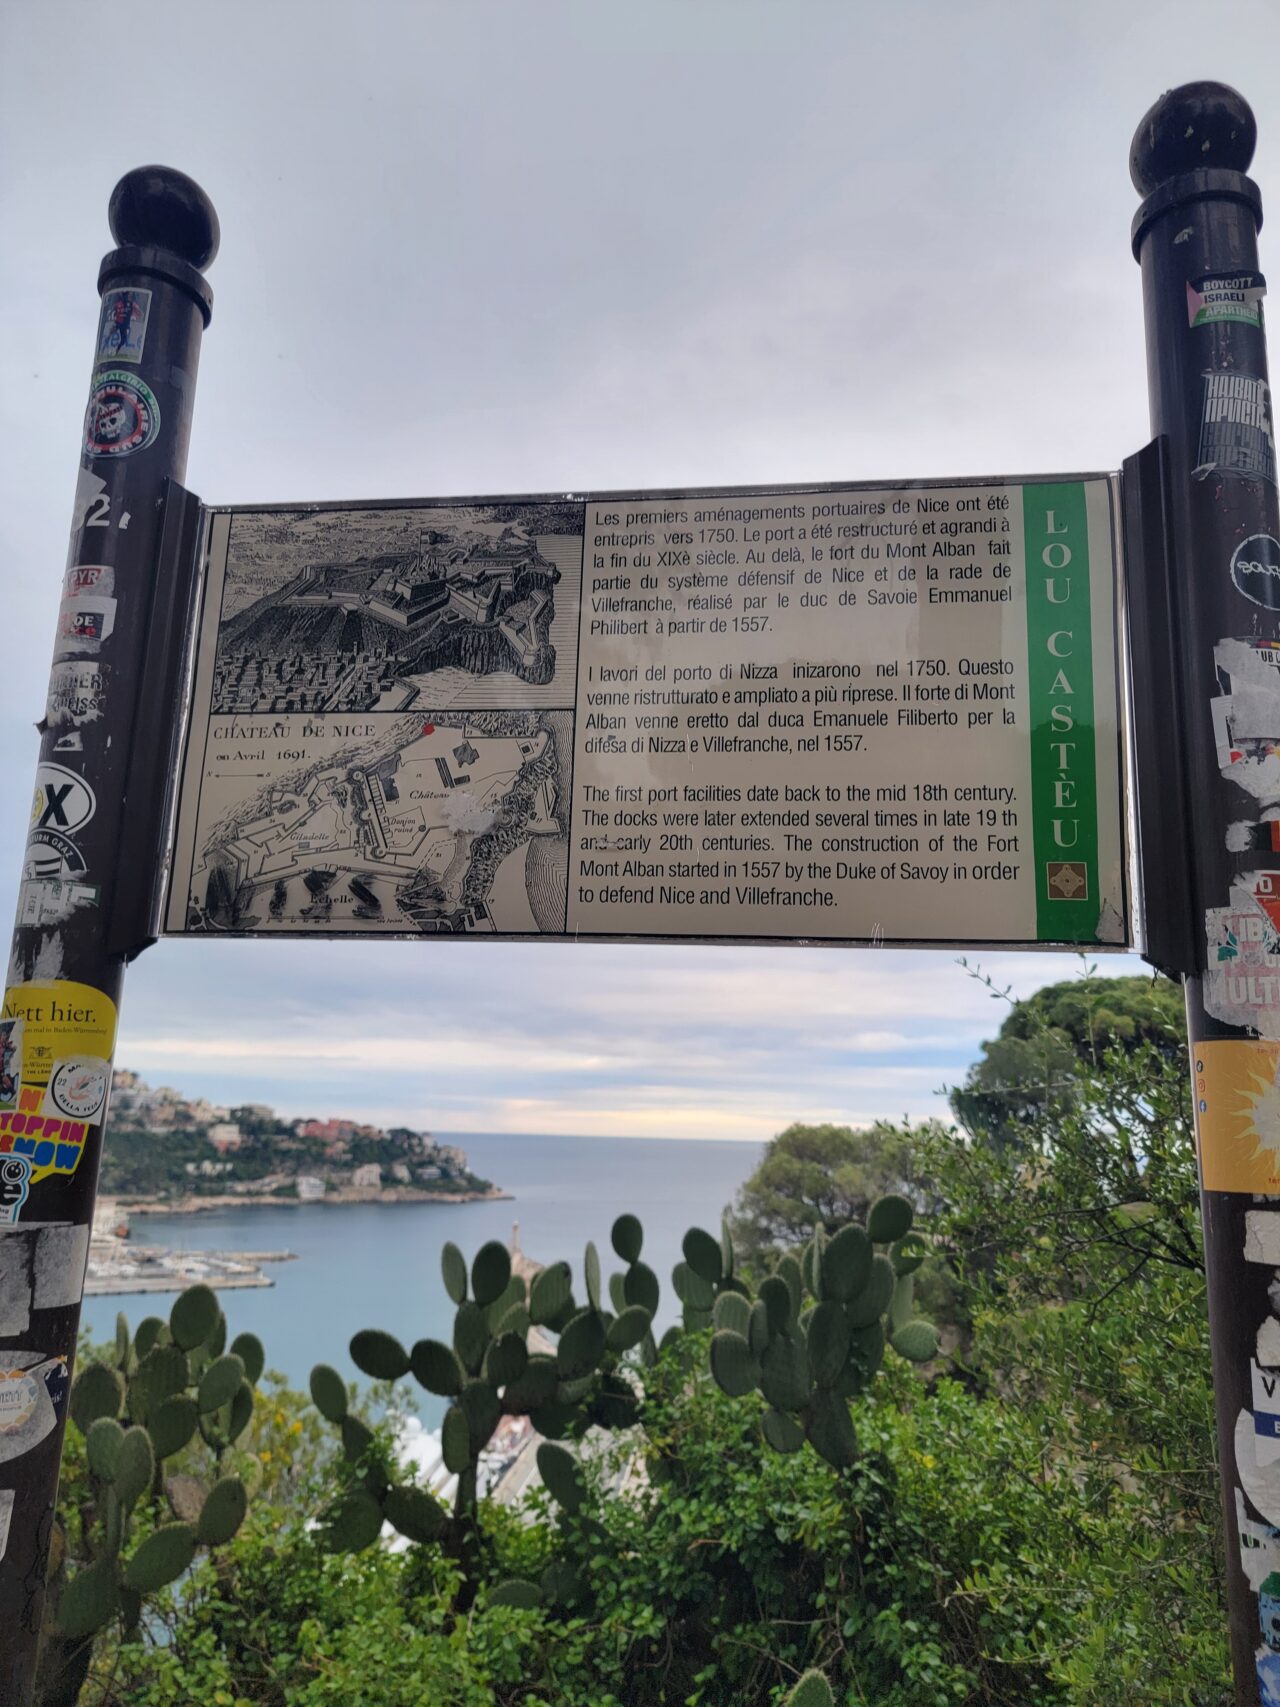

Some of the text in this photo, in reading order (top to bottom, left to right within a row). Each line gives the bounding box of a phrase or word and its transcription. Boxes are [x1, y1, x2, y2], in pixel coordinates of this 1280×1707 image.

[1203, 278, 1252, 290] BOYCOTT
[1204, 292, 1245, 304] ISRAELI
[1206, 305, 1258, 319] APARTHEID
[596, 496, 1009, 527] Les premiers aménagements portuaires de Nice ont été
[594, 517, 996, 548] entrepris vers 1750. Le port été restructuré et agrandi
[594, 540, 1011, 568] la fin du XIXè siècle. Au delà, le fort du Mont Alban fait
[593, 563, 1011, 593] partie du système défensif de Nice et de la rade de
[592, 586, 1011, 613] Villefranche, réalisé par le duc de Savoie Emmanuel
[591, 617, 772, 637] Philibert partir de 1557.
[600, 659, 1013, 683] lavori del porto di Nizza inizarono nel 1750. Questo
[1042, 510, 1080, 848] LOU CASTÈU
[587, 683, 1015, 706] venne ristrutturato ampliato più riprese. Il forte di Mont
[586, 708, 1015, 729] Alban venne eretto dal duca Emanuele Filiberto per la
[302, 725, 325, 738] DE
[332, 724, 376, 737] NICE
[585, 735, 867, 754] difesa di Nizza Villefranche, nel 1557.
[233, 750, 265, 760] Avril
[583, 784, 1016, 804] The first port facilities date back to the mid 18th century.
[582, 810, 1017, 826] The docks were later extended several times in late 19 th
[580, 834, 1019, 854] and early 20th centuries. The construction of the Fort
[580, 861, 1020, 883] Mont Alban started in 1557 by the Duke of Savoy in order
[579, 886, 837, 906] to defend Nice and Villefranche.
[5, 1001, 97, 1023] Nett hier.
